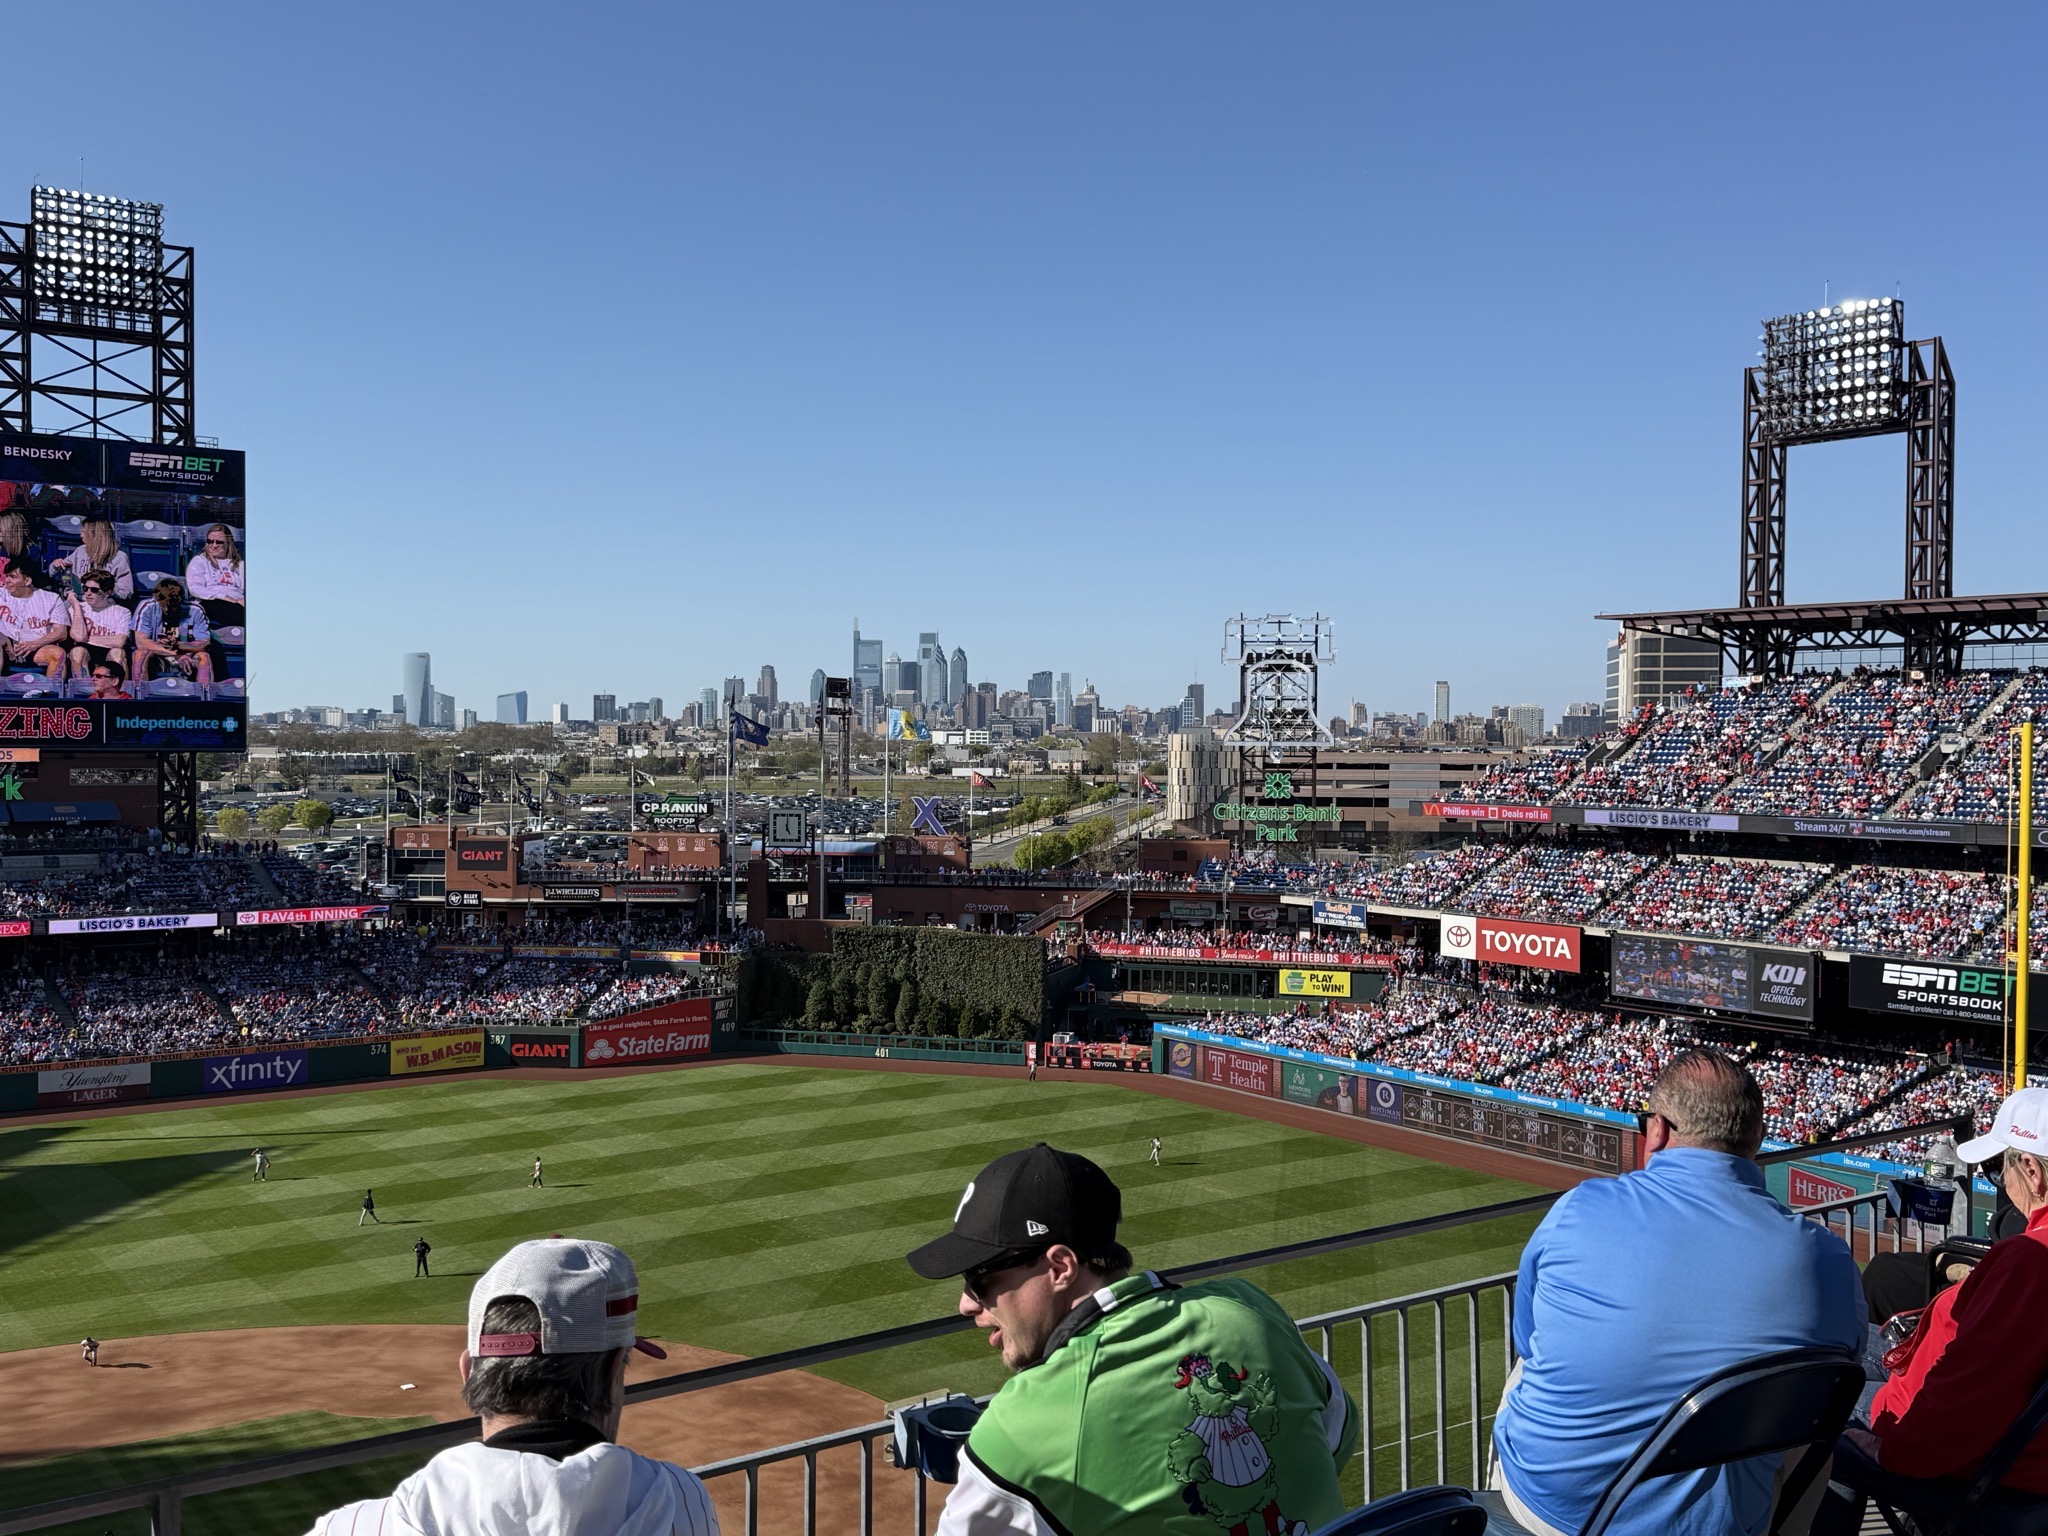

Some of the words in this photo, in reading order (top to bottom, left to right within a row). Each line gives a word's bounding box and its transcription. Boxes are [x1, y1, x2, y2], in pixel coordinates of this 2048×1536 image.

[4, 446, 72, 460] BENDESKY
[184, 456, 225, 473] BET
[140, 469, 214, 482] SPORTSBOOK
[116, 716, 219, 731] Independence
[642, 803, 660, 812] CP
[662, 803, 708, 814] RANKIN
[1214, 803, 1290, 820] Citizens
[1293, 804, 1342, 821] Bank
[1443, 807, 1469, 816] Phillies
[1472, 808, 1484, 816] win
[1502, 809, 1523, 818] Deals
[1526, 810, 1538, 819] roll
[1540, 811, 1548, 819] in
[1609, 812, 1658, 824] LISCIO'S
[1662, 814, 1710, 827] BAKERY
[1794, 821, 1827, 832] Stream
[1828, 823, 1846, 833] 24/7
[1865, 826, 1950, 836] MLBNetwork.com/stream
[1256, 824, 1298, 842] Park
[462, 851, 503, 861] GIANT
[262, 911, 306, 923] RAV4th
[310, 908, 359, 920] INNING
[78, 919, 134, 930] LISCIO'S
[138, 917, 189, 928] BAKERY
[1482, 930, 1572, 959] TOYOTA
[1310, 974, 1334, 983] PLAY
[1762, 964, 1807, 985] KDI
[1882, 963, 1958, 990] ESPN
[1322, 984, 1344, 993] WIN!
[1771, 985, 1796, 996] OFFICE
[1760, 993, 1807, 1006] TECHNOLOGY
[1897, 990, 2003, 1010] SPORTSBOOK
[716, 1010, 729, 1020] ANGLE
[1888, 1002, 1914, 1012] Gambling
[1916, 1006, 1942, 1015] problem?
[1955, 1010, 2002, 1022] 1-800-GAMBLER.
[625, 1021, 652, 1029] neighbor,
[721, 1022, 735, 1032] 409
[432, 1028, 478, 1037] ASPLUNDH
[1162, 1026, 1184, 1036] Independence
[315, 1038, 364, 1048] ASPLUNDH
[374, 1033, 421, 1042] ASPLUNDH
[490, 1034, 505, 1045] 387
[255, 1043, 304, 1053] ASPLUNDH
[370, 1045, 387, 1055] 374
[512, 1043, 569, 1057] GIANT
[1241, 1041, 1265, 1050] Independence
[193, 1048, 245, 1058] ASPLUNDH
[875, 1048, 889, 1058] 401
[62, 1059, 118, 1070] ASPLUNDH
[129, 1054, 182, 1064] ASPLUNDH
[1229, 1054, 1268, 1075] Temple
[1323, 1057, 1350, 1068] Independence
[211, 1056, 302, 1089] xfinity
[1376, 1067, 1393, 1076] ibx.com
[59, 1069, 130, 1089] Yuengling
[1230, 1071, 1265, 1091] Health
[1415, 1075, 1446, 1086] Independence
[73, 1088, 117, 1102] LAGER
[1382, 1090, 1389, 1100] R
[1474, 1086, 1494, 1095] ibx.com
[1422, 1099, 1433, 1110] STL
[1438, 1102, 1442, 1111] 0
[1518, 1095, 1551, 1106] Independence
[1370, 1106, 1400, 1116] ROTHMAN
[1473, 1110, 1485, 1120] SEA
[1489, 1113, 1495, 1122] 11
[1500, 1103, 1516, 1112] TOWN
[1518, 1108, 1539, 1118] SCORES
[1584, 1107, 1605, 1117] ibx.com
[1422, 1110, 1434, 1122] NYM
[1438, 1114, 1441, 1123] 0
[1473, 1121, 1483, 1132] CIN
[1489, 1125, 1493, 1134] 7
[1525, 1121, 1540, 1133] WSH
[1544, 1124, 1548, 1134] 0
[2009, 1125, 2038, 1140] Phillies
[1527, 1133, 1537, 1144] PIT
[1585, 1133, 1594, 1144] AZ
[1583, 1145, 1596, 1157] MIA
[1602, 1150, 1607, 1159] 4
[1843, 1157, 1870, 1168] ibx.com
[1795, 1178, 1848, 1202] HERR'S
[1916, 1204, 1936, 1212] Citizens
[1221, 1424, 1253, 1447] Phillies
